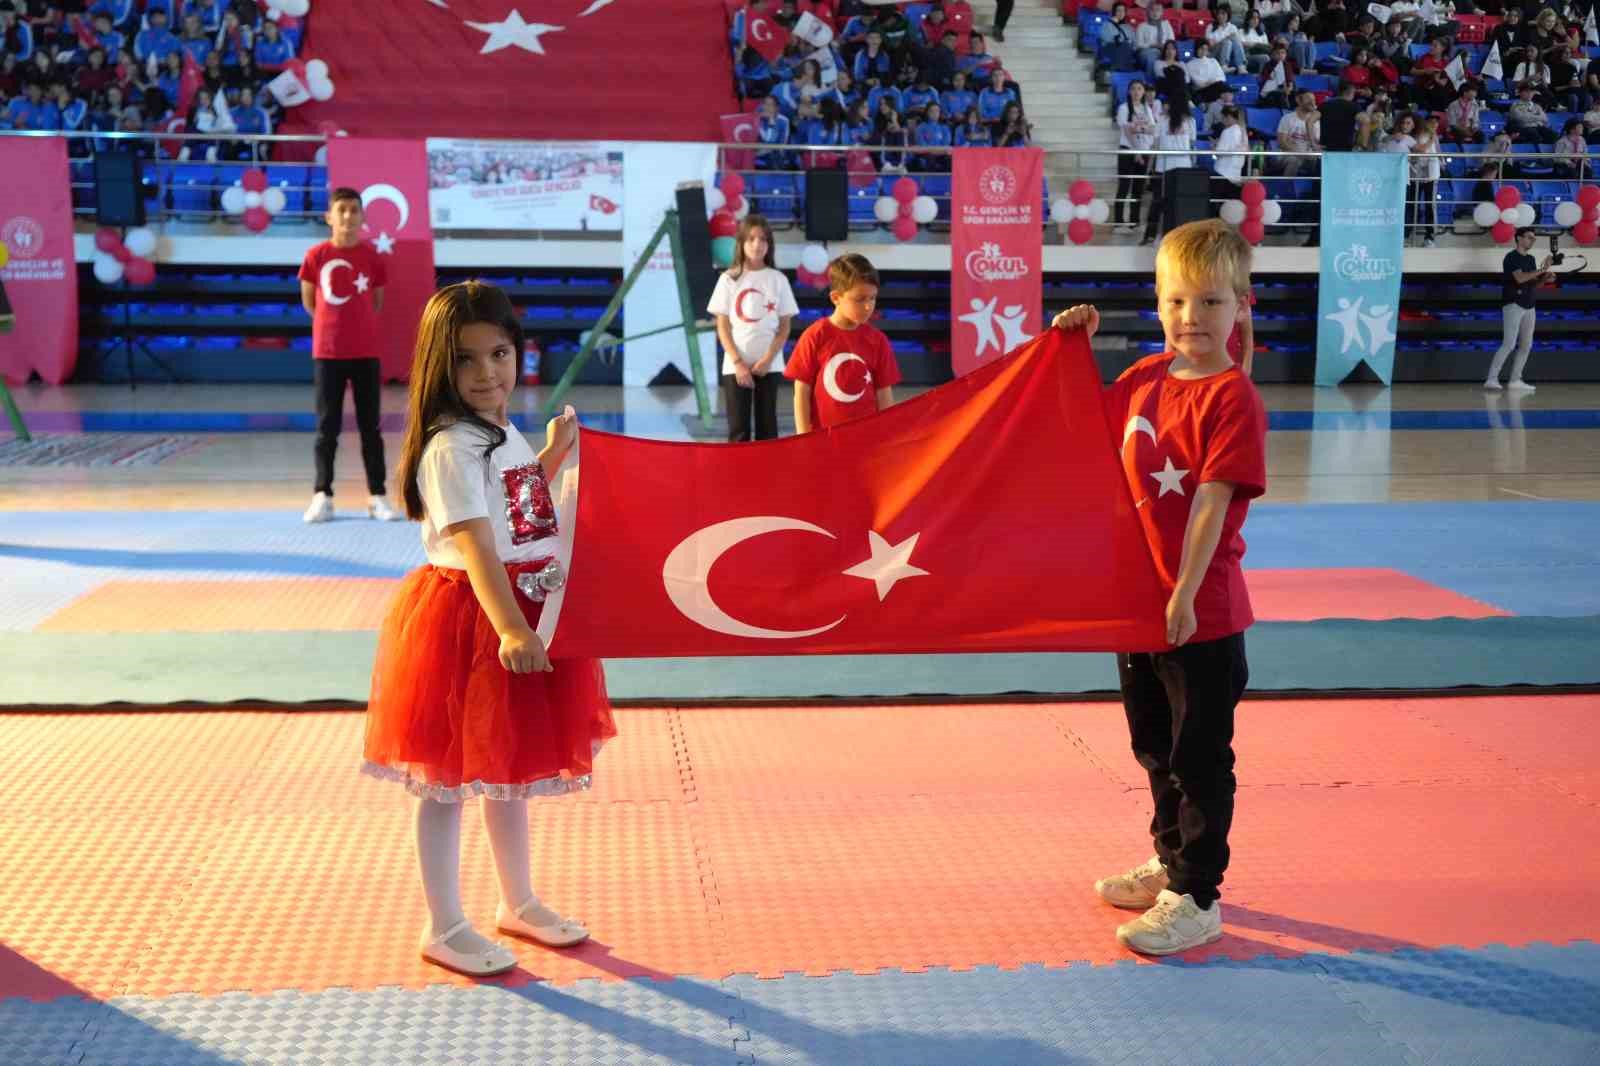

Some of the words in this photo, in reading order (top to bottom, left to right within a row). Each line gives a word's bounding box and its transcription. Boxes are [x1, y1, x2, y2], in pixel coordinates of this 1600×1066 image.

[1020, 205, 1031, 214] VE
[963, 216, 984, 225] SPOR
[974, 256, 1028, 275] OKUL
